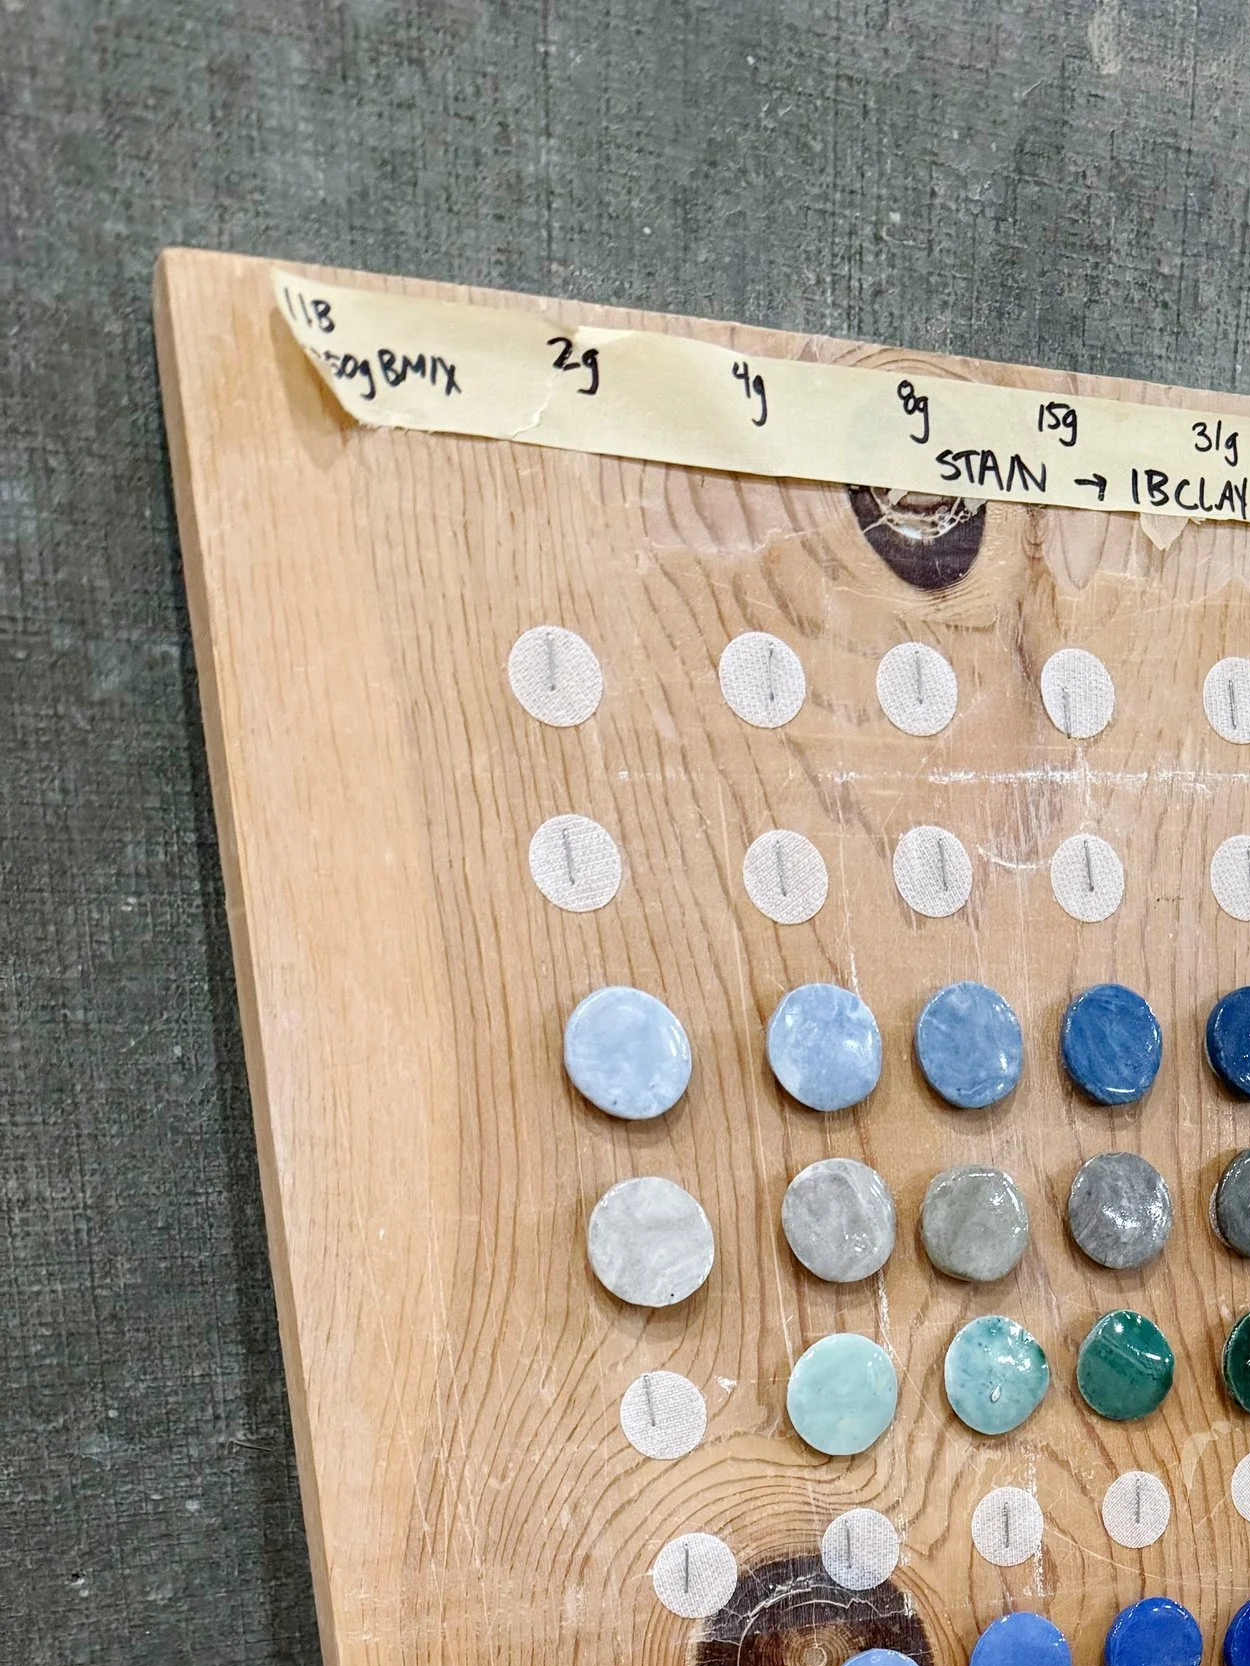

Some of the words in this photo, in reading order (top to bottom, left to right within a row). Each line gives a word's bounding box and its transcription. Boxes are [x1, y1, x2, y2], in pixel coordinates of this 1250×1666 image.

[378, 348, 463, 397] BMIX
[547, 334, 601, 395] 2g
[731, 360, 769, 427] 4g
[1037, 402, 1079, 447] 15g
[1193, 420, 1239, 466] 31g
[935, 449, 1047, 493] STAIN
